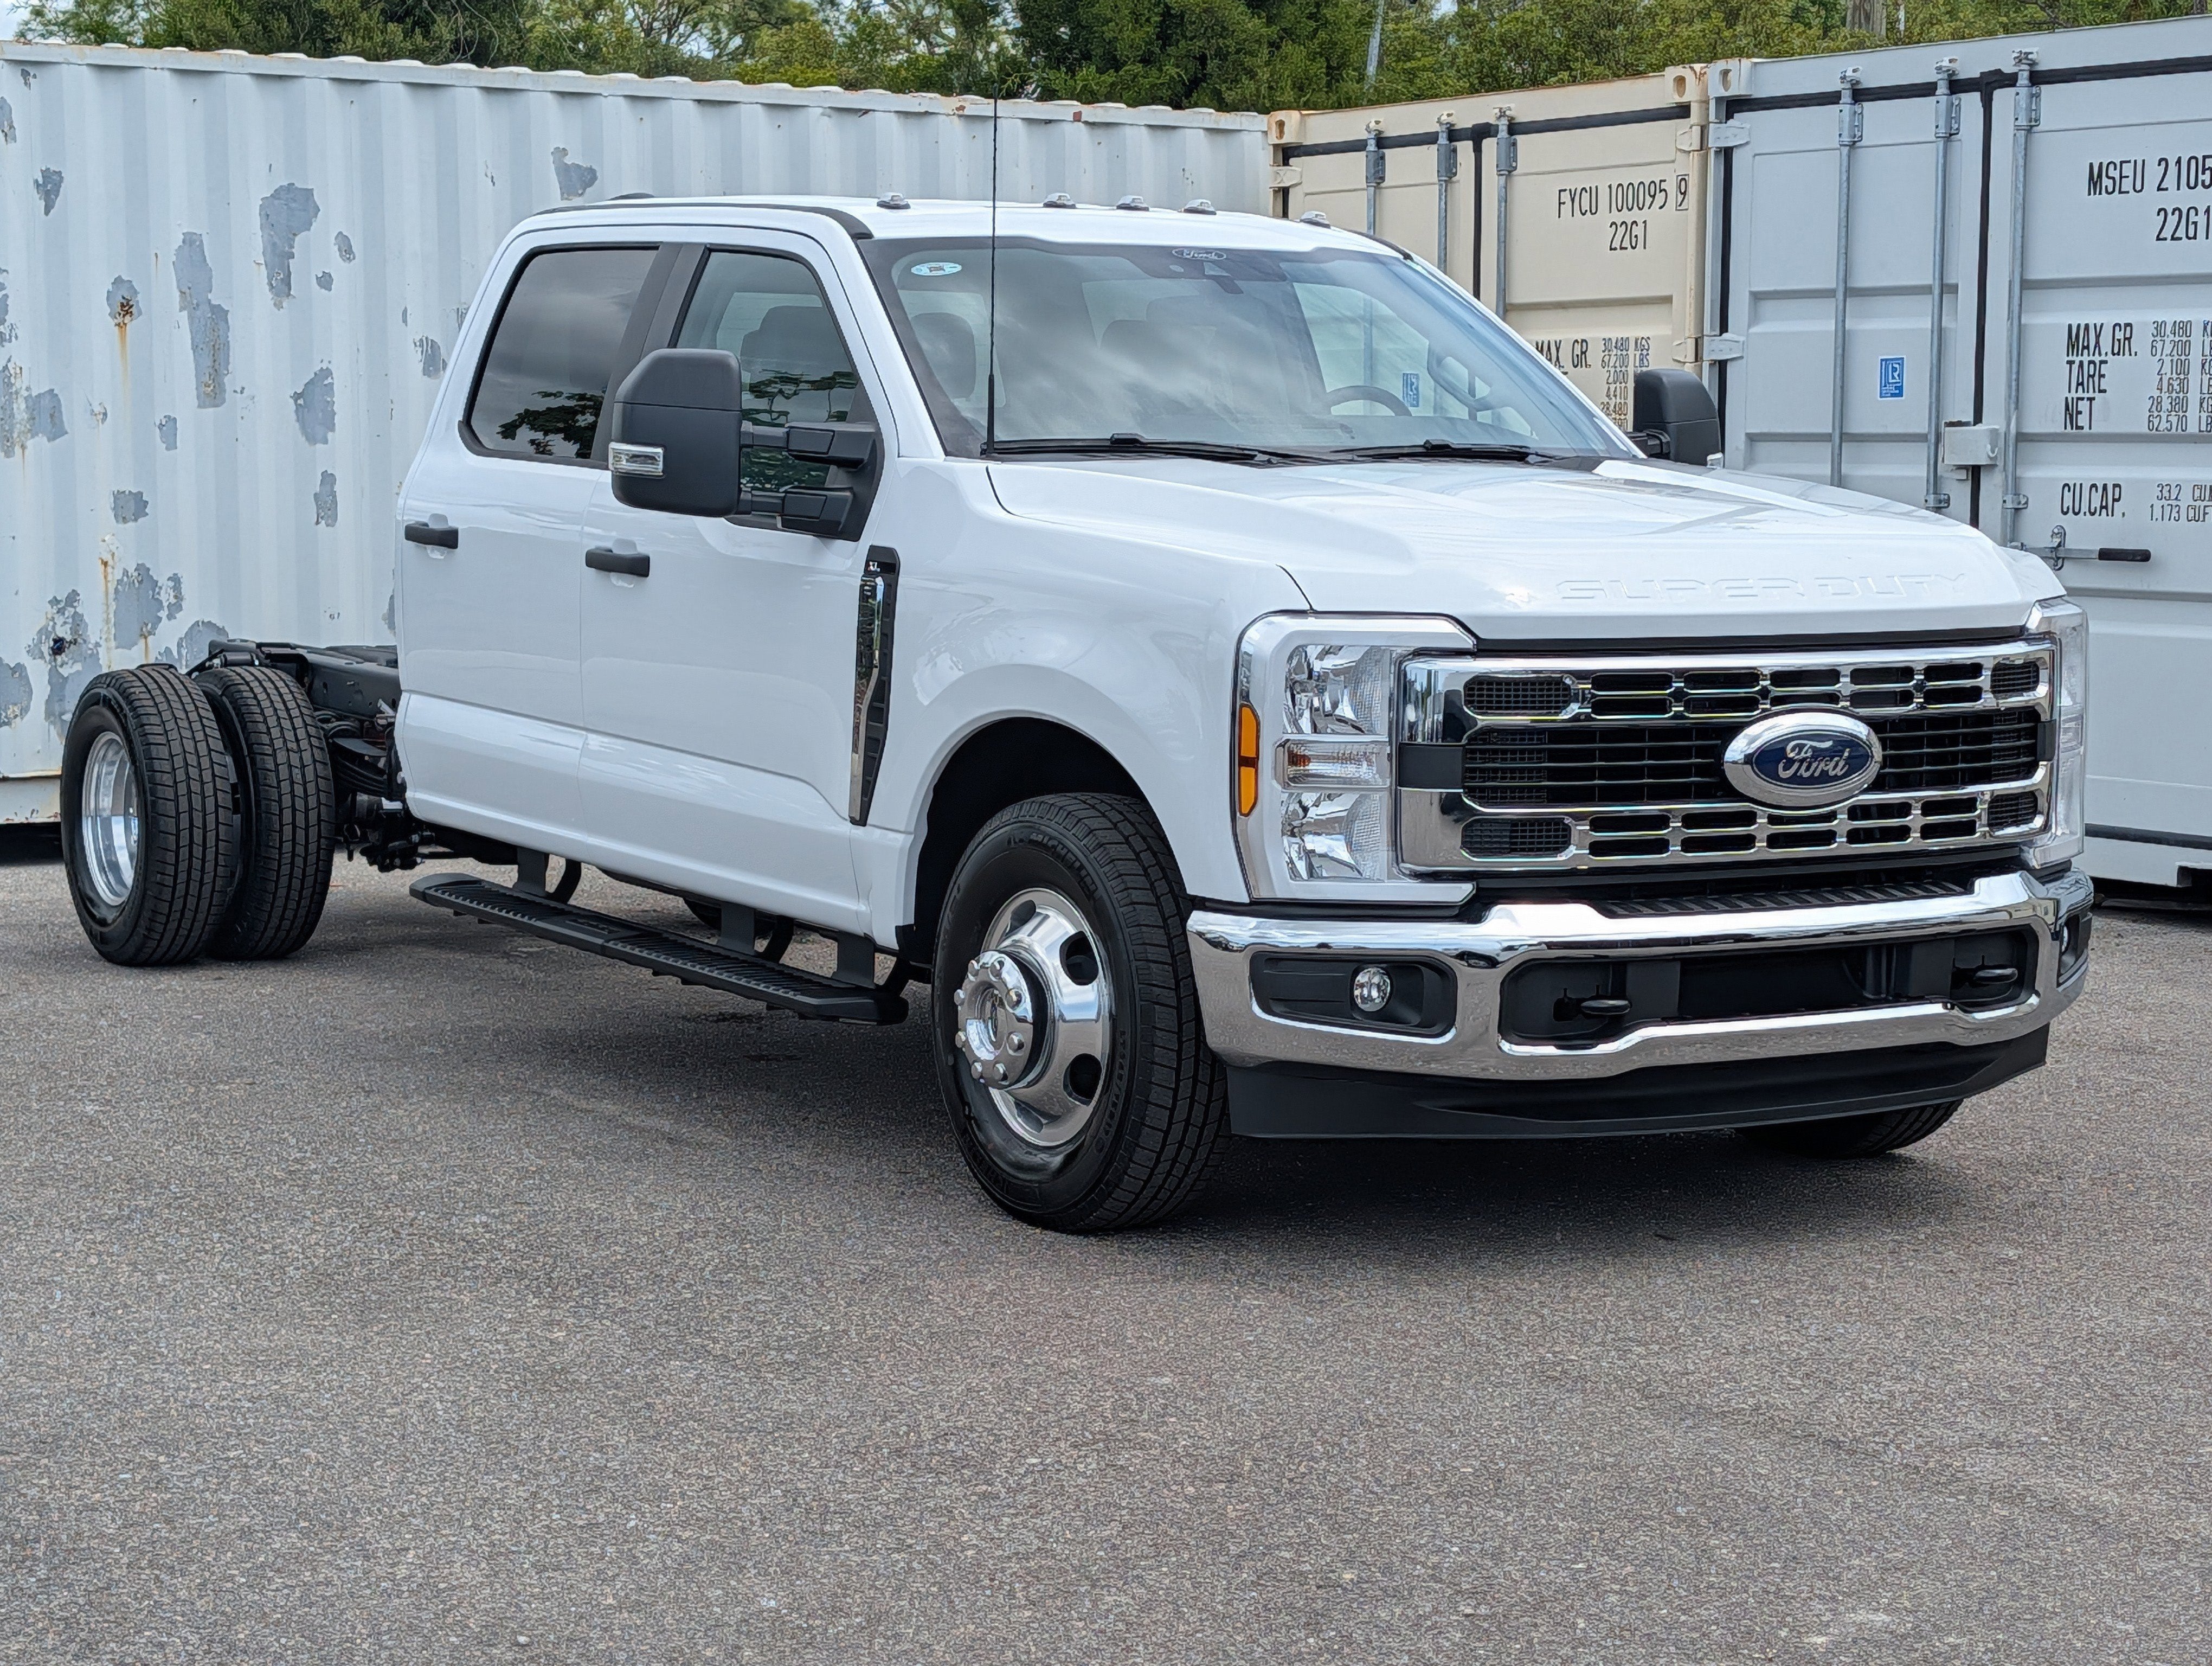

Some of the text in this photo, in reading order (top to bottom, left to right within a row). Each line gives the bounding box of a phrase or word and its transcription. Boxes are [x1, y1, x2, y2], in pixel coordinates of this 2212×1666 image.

[2087, 155, 2212, 196] MSEU 2105
[1558, 177, 1687, 218] FYCU 100095 9
[1609, 220, 1647, 251] 22G1
[2156, 205, 2211, 241] 22G1
[2066, 360, 2108, 394] TARE
[2064, 396, 2095, 431] NET
[1555, 573, 1965, 603] SUPER DUTY
[1778, 739, 1851, 779] Ford
